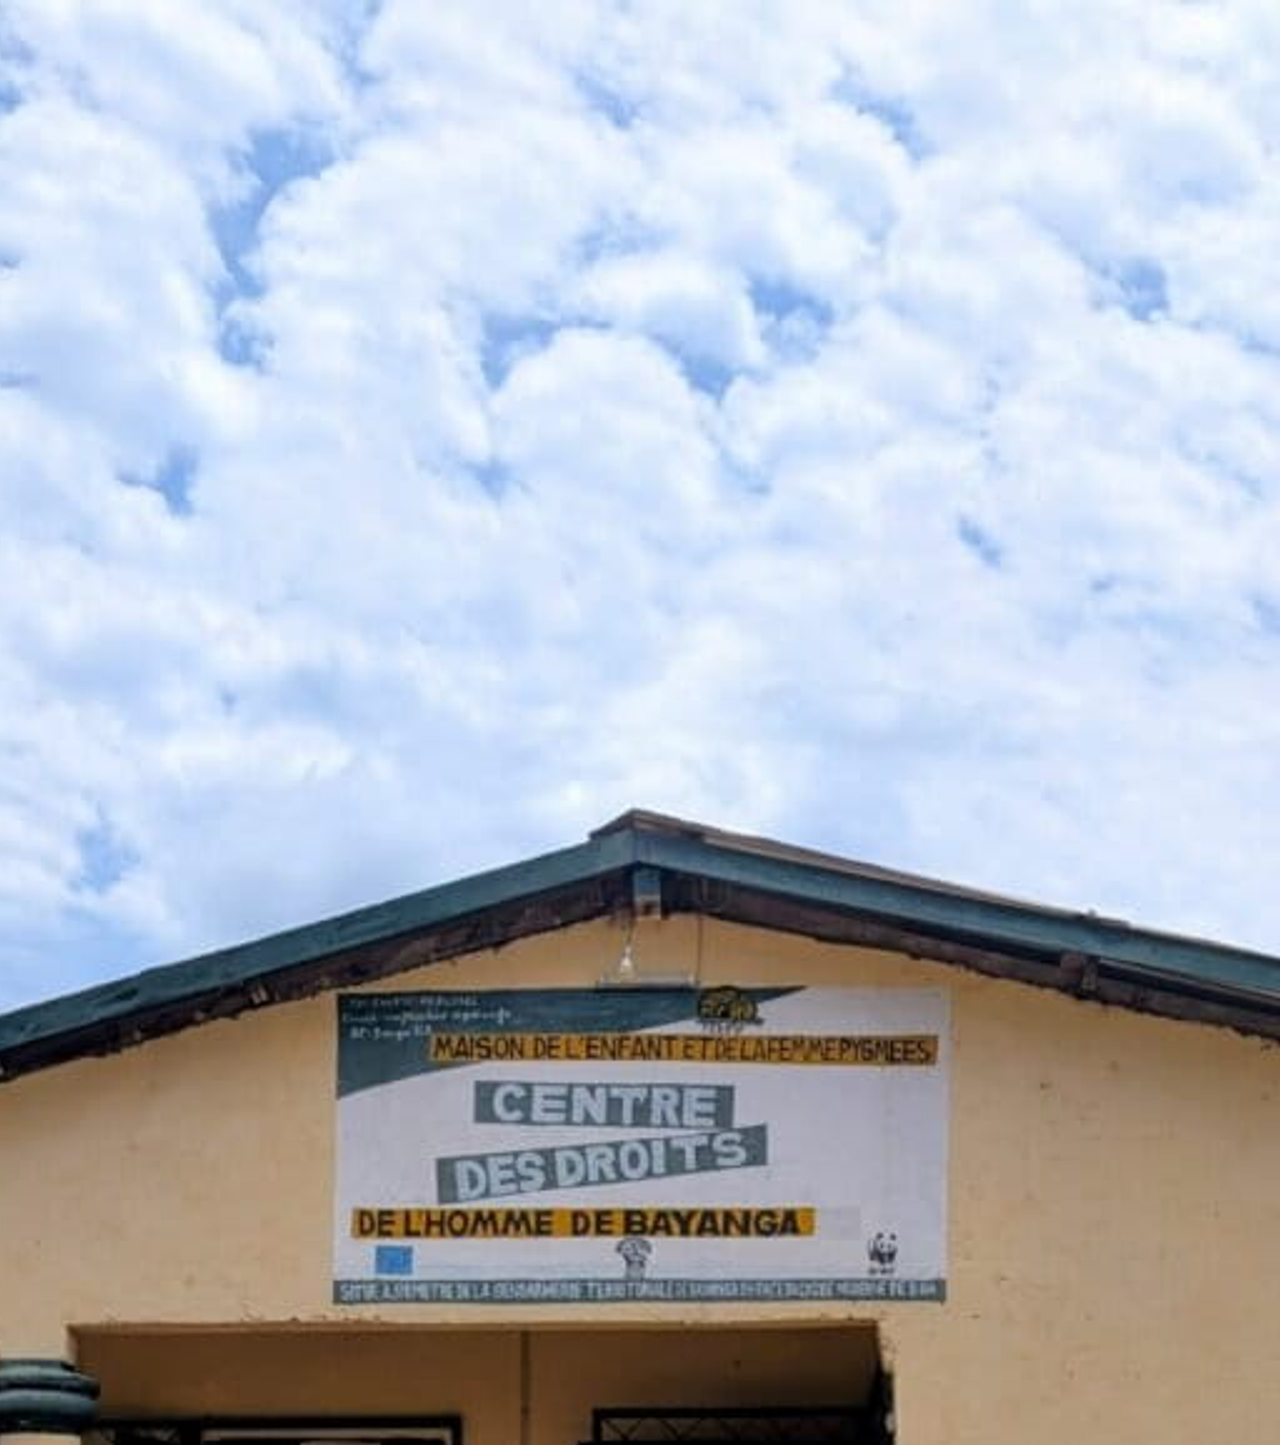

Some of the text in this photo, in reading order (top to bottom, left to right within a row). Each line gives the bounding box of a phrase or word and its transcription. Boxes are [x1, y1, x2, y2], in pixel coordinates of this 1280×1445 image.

[433, 1036, 522, 1060] MAISON
[533, 1036, 562, 1060] DE
[491, 1084, 717, 1127] CENTRE
[455, 1131, 748, 1201] DES DROITS
[358, 1208, 397, 1237] DE
[572, 1208, 619, 1236] DE
[623, 1207, 801, 1237] BAYANGA
